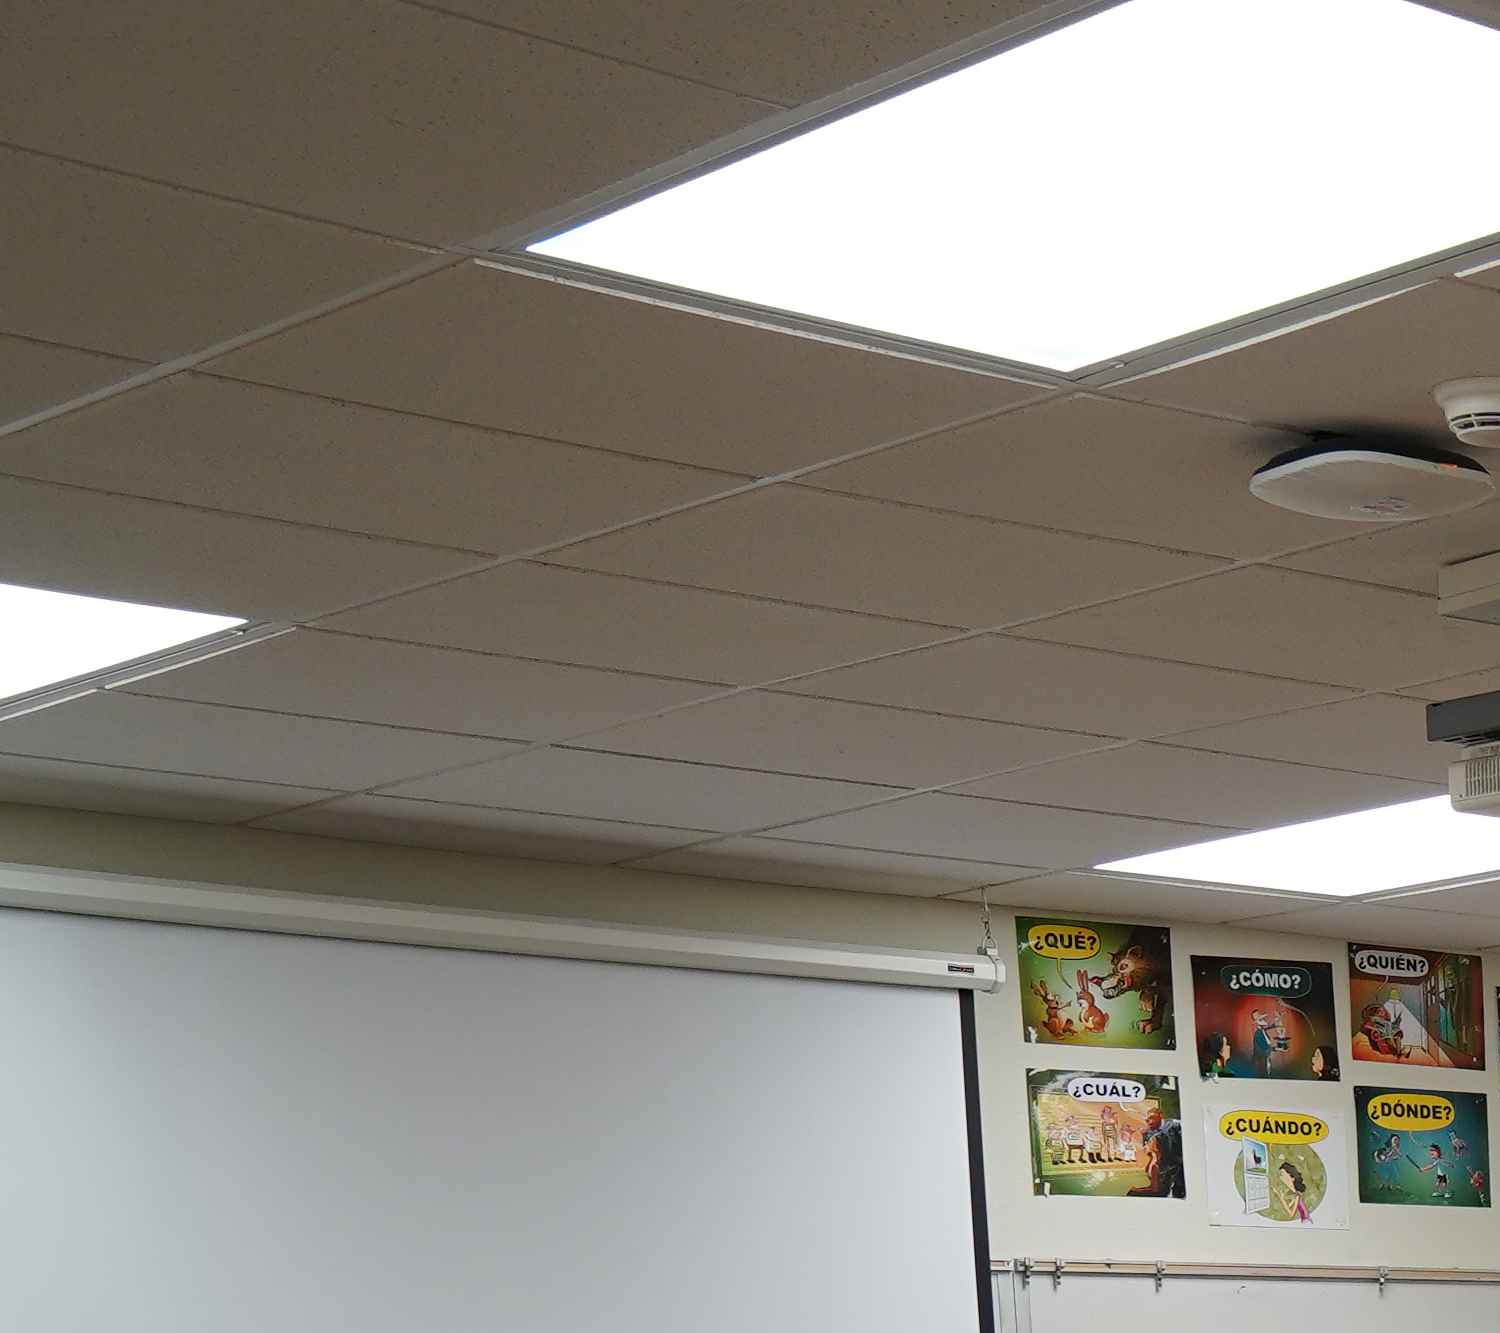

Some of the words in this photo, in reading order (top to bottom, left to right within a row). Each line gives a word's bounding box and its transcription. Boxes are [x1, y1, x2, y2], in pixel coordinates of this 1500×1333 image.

[1032, 930, 1097, 953] ¿QUÉ?
[1357, 952, 1427, 974] ¿QUIÉN?
[1229, 969, 1301, 992] ¿CÓMO?
[1073, 1080, 1141, 1100] ¿CUÁL?
[1370, 1101, 1452, 1122] ¿DÓNDE?
[1225, 1115, 1322, 1137] ¿CUÁNDO?
